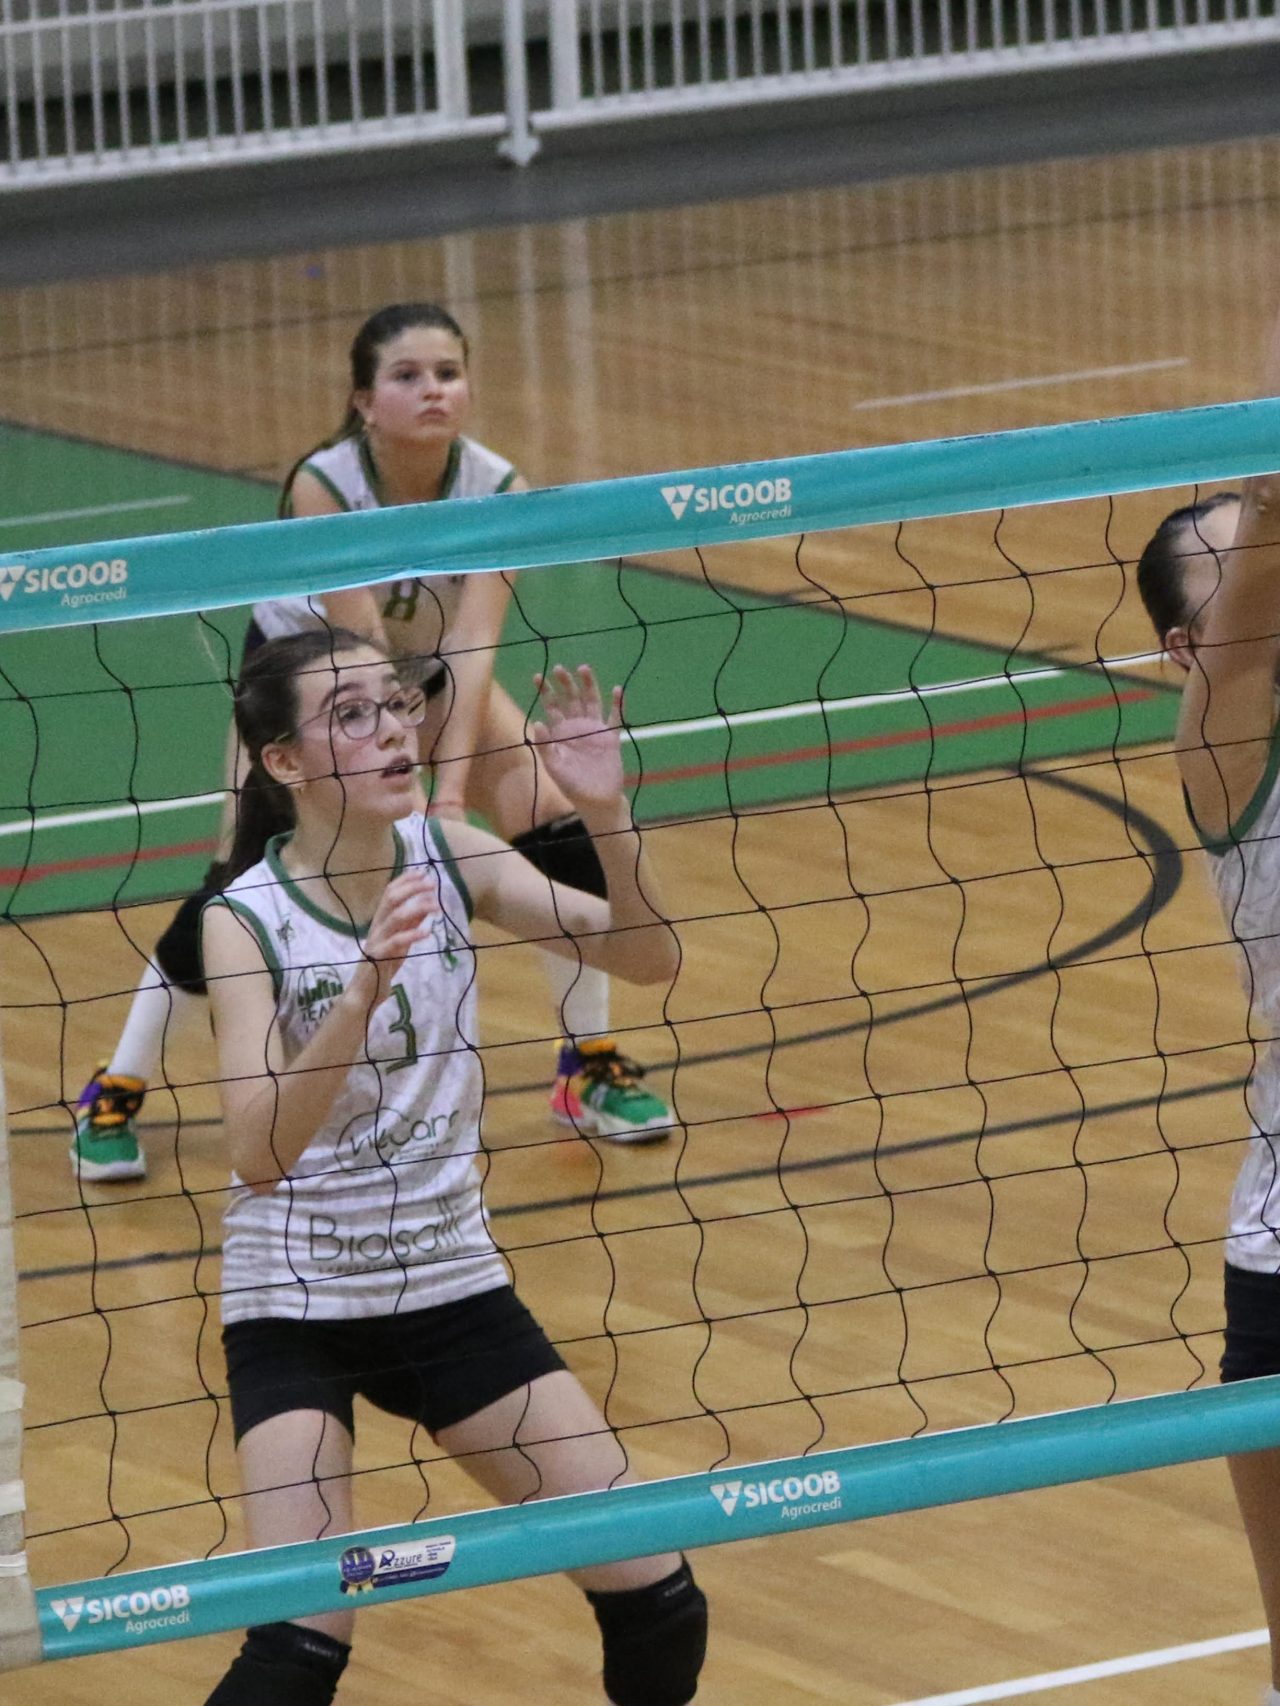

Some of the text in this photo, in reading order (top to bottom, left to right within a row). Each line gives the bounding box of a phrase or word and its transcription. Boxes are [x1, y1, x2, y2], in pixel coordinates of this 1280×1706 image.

[695, 477, 792, 513] SICOOB
[729, 505, 792, 526] Agrocredi
[24, 559, 128, 594] SICOOB
[61, 586, 127, 608] Agrocredi
[385, 983, 419, 1075] 3
[743, 1470, 841, 1508] SICOOB
[781, 1496, 842, 1520] Agrocredi
[86, 1584, 191, 1624] SICOOB
[125, 1609, 190, 1634] Agrocredi
